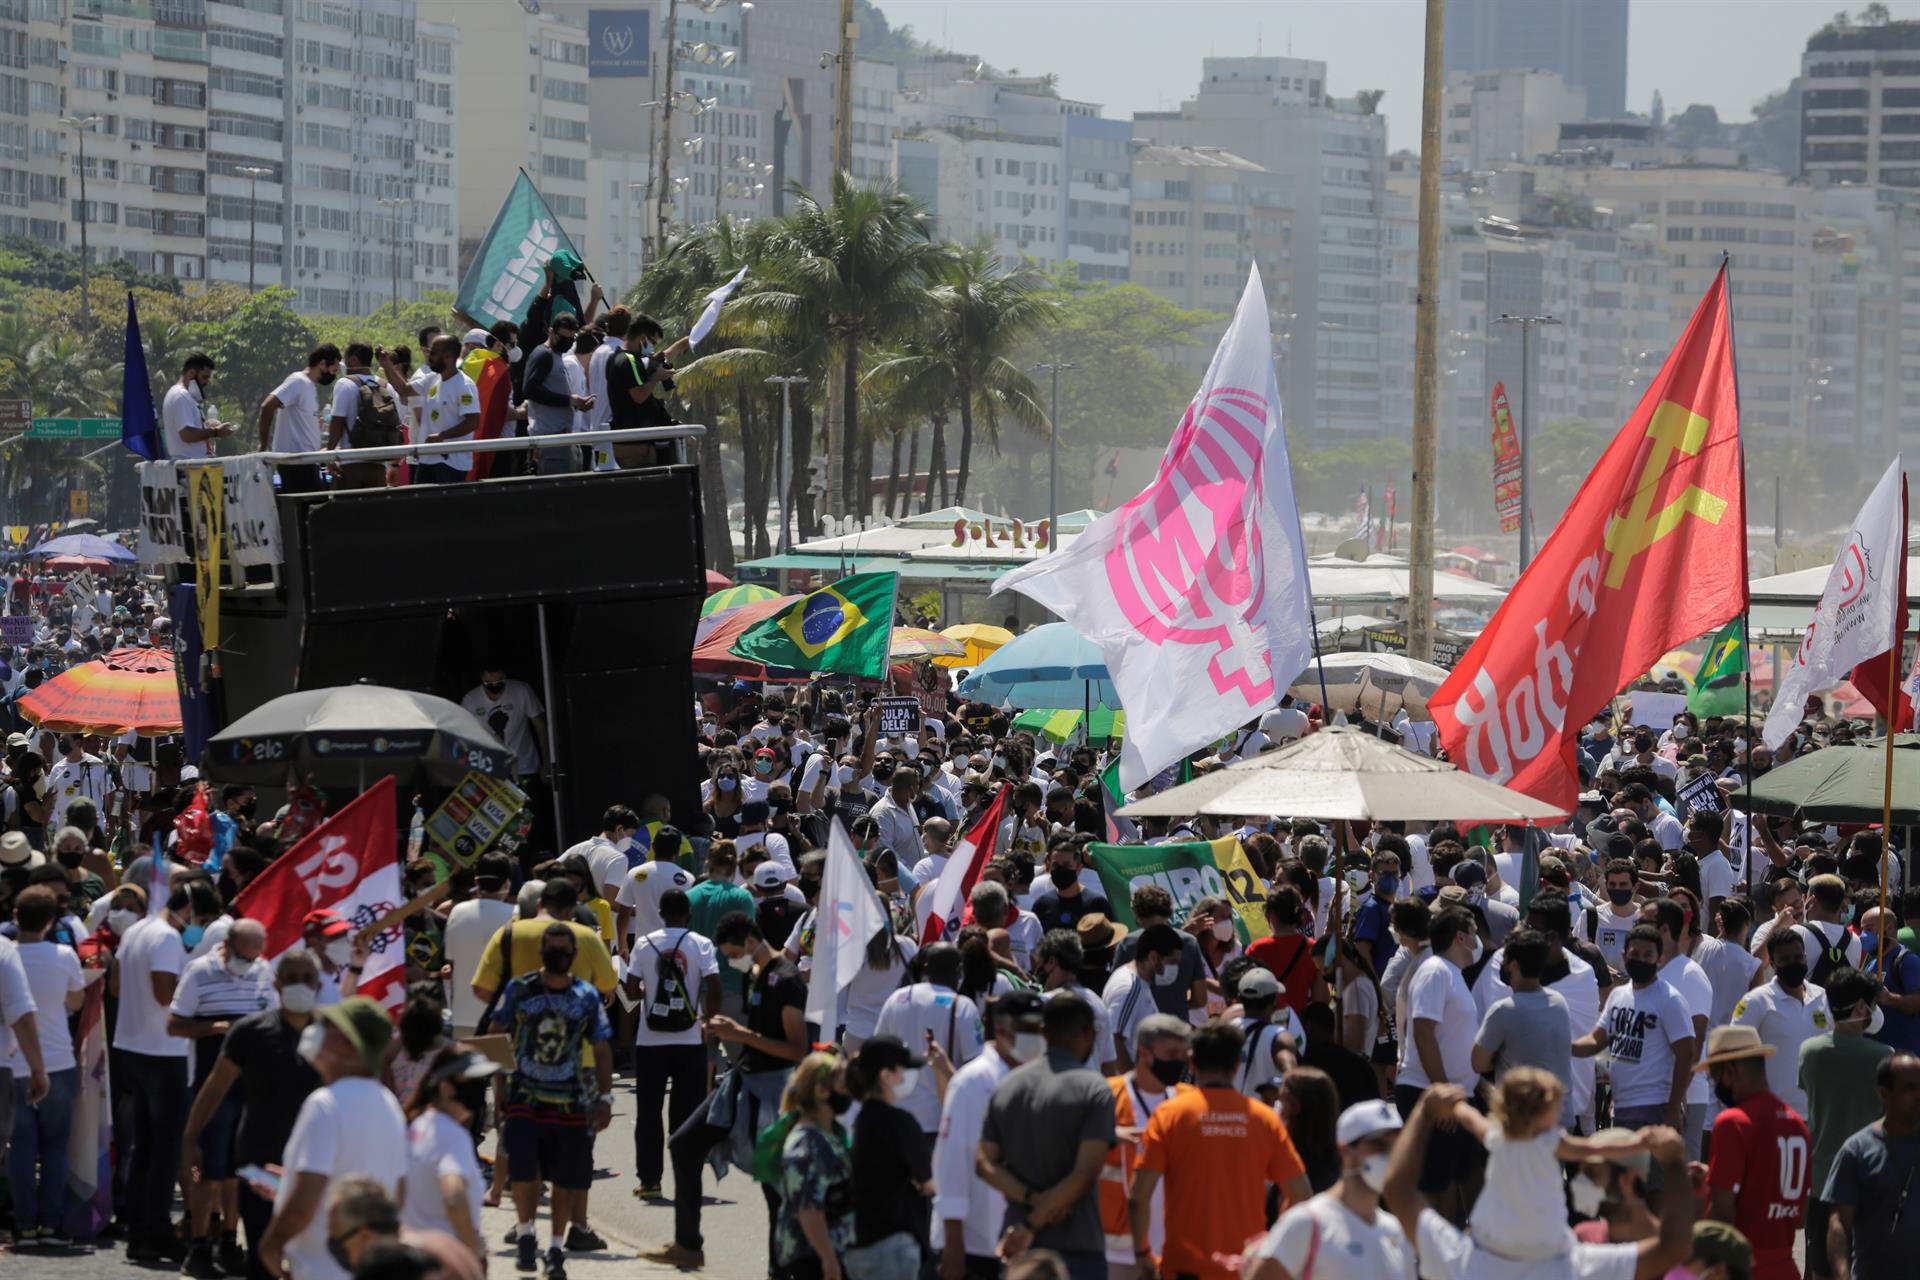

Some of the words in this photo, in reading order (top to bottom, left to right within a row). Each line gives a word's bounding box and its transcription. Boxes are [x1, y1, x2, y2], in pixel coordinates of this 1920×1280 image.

[952, 518, 1050, 549] SOLARIS
[487, 801, 507, 822] VISA
[472, 819, 491, 840] VISA
[294, 835, 359, 901] 12
[1219, 868, 1266, 904] 12
[1777, 1136, 1807, 1200] 10
